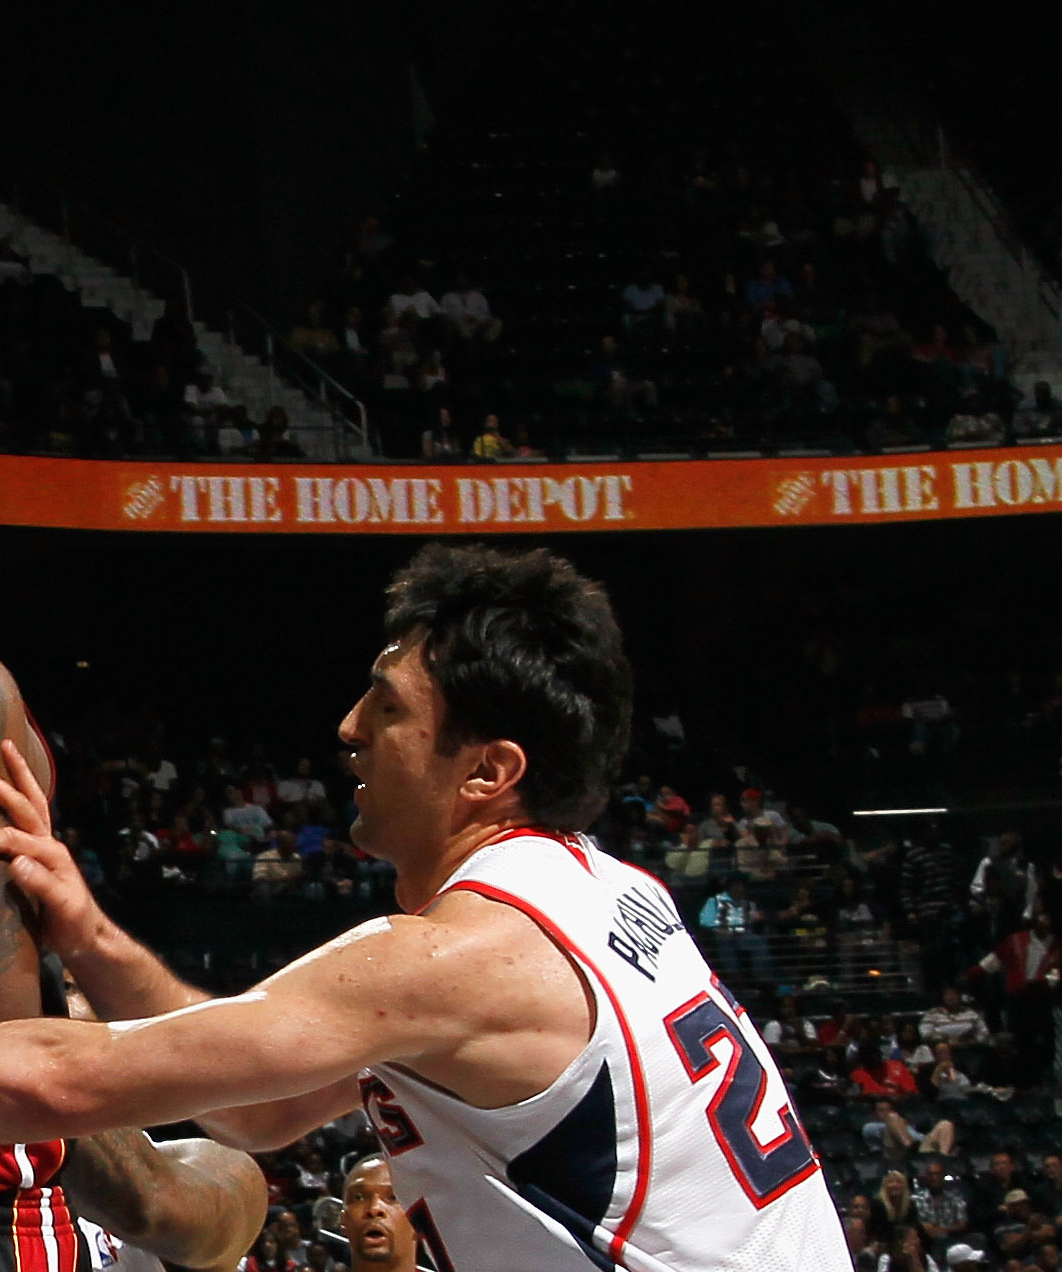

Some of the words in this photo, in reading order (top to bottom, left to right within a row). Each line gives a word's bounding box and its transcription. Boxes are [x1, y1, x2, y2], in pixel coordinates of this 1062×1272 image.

[170, 476, 282, 522] THE
[293, 476, 444, 524] HOME
[455, 475, 633, 523] DEPOT
[821, 464, 937, 515] THE
[663, 973, 821, 1210] 2
